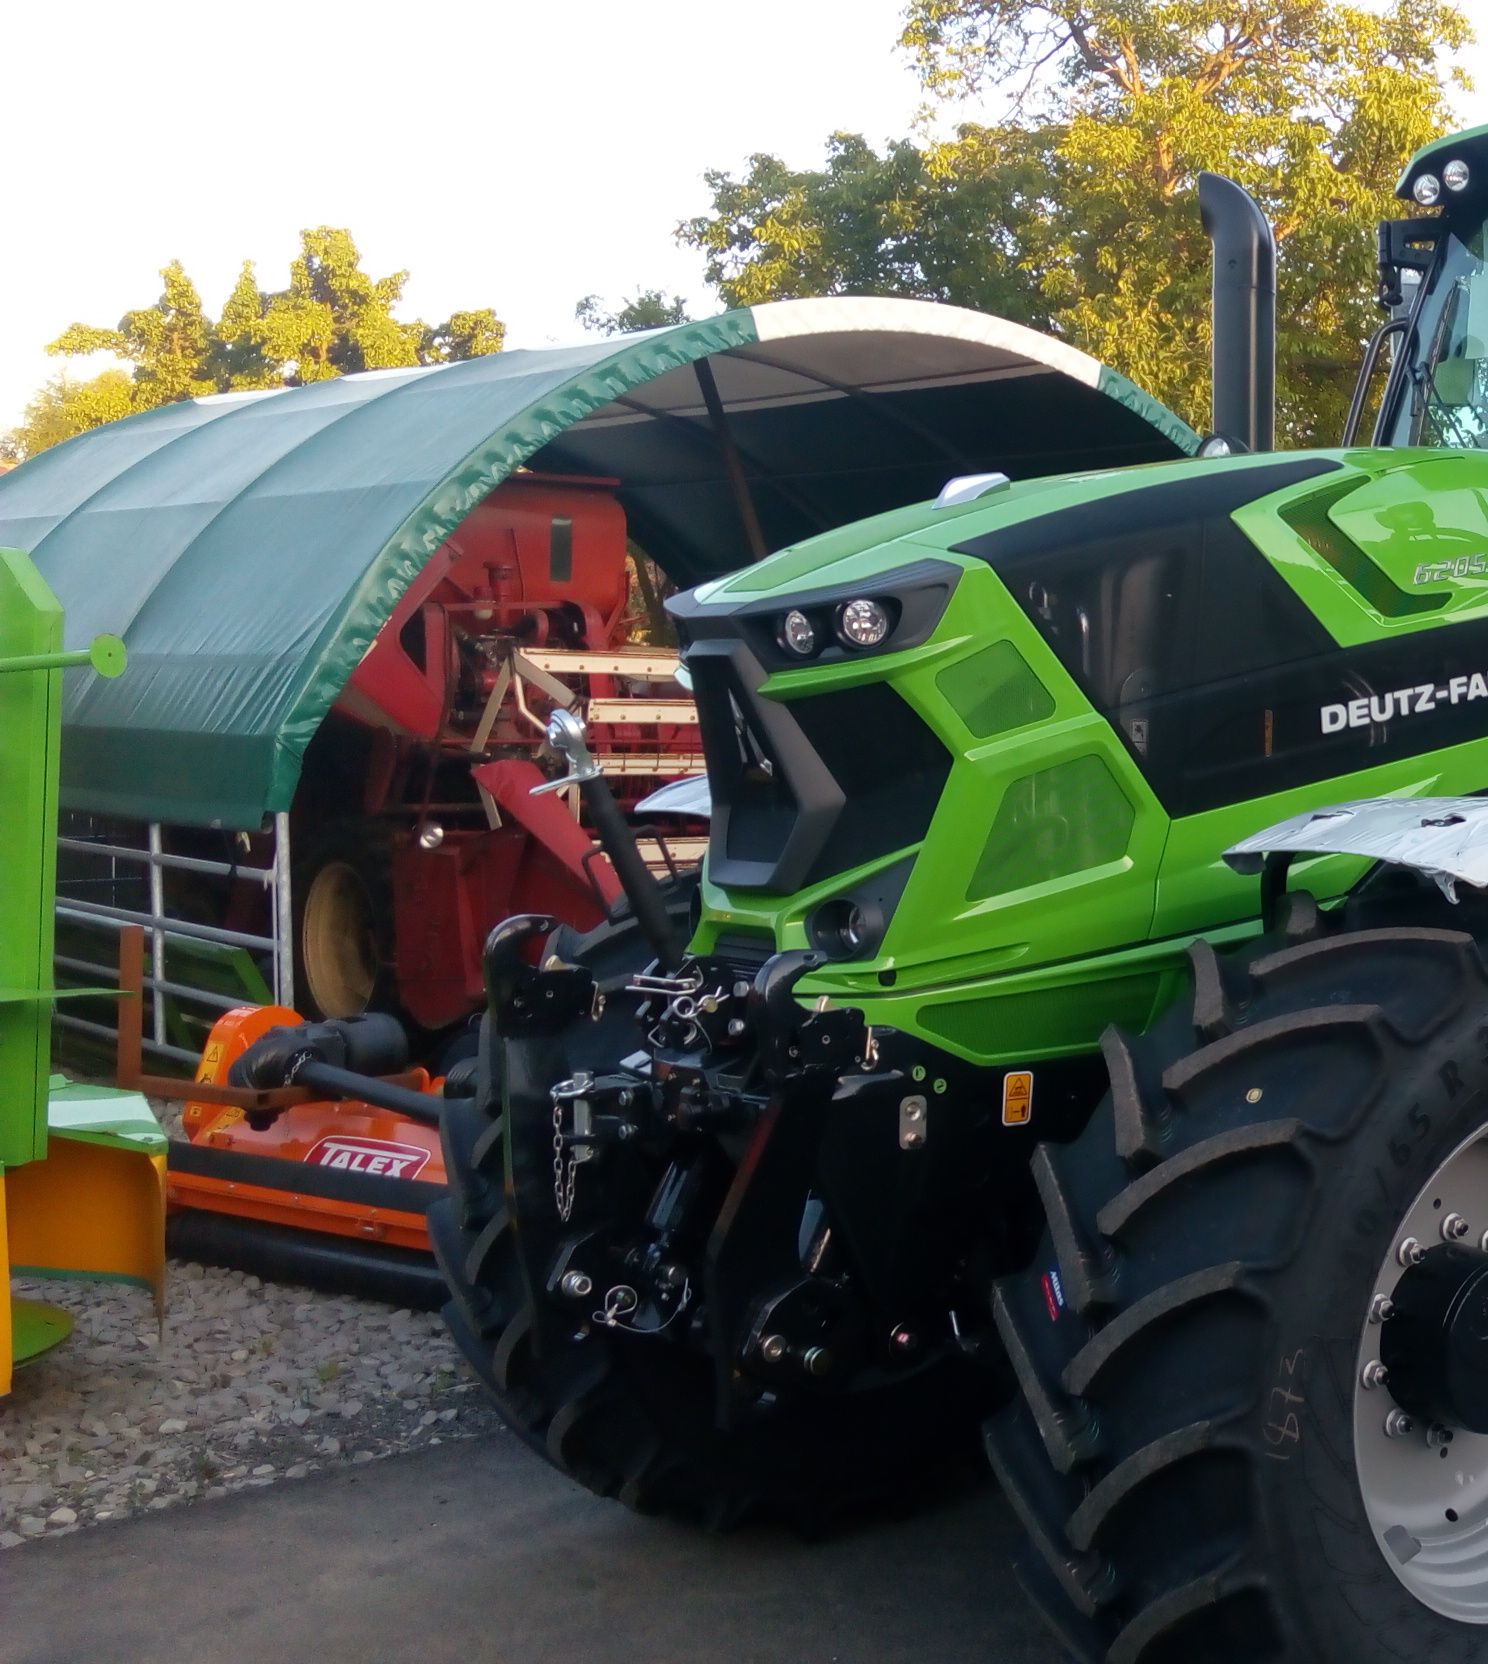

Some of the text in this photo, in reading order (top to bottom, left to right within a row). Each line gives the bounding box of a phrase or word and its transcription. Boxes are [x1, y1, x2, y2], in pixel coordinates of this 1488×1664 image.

[1413, 553, 1487, 585] 6205
[1438, 1058, 1464, 1100] R
[319, 1141, 421, 1178] TALEX
